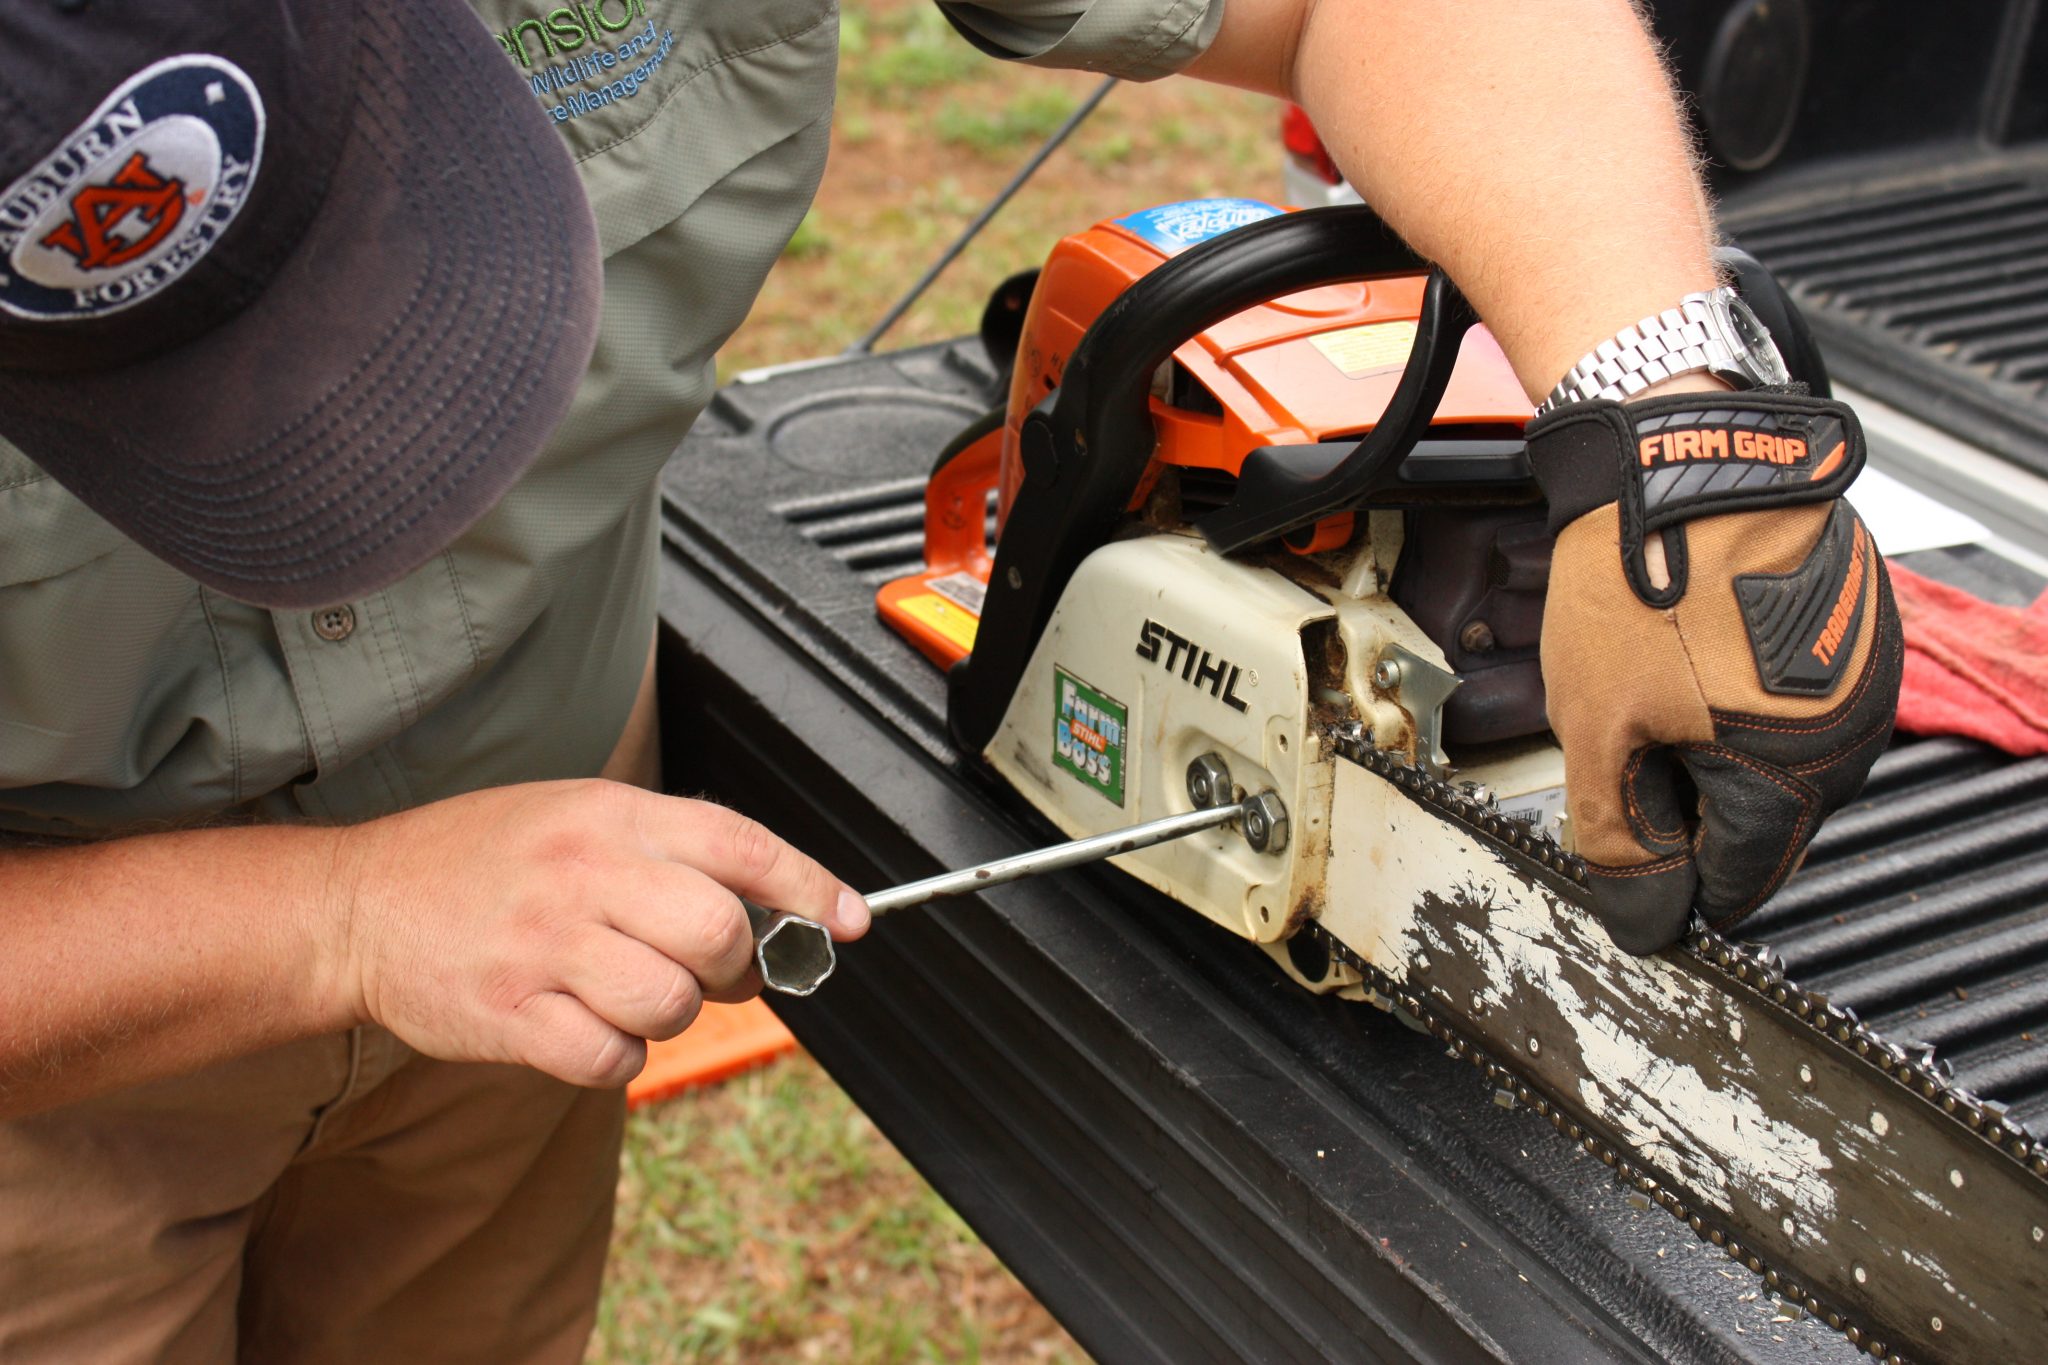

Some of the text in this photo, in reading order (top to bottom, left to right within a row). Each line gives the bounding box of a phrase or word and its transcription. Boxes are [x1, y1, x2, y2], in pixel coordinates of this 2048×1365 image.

[531, 19, 658, 97] Wildlife and
[566, 28, 674, 119] Management
[0, 96, 146, 254] AUBURN
[74, 153, 251, 308] FORESTRY
[1640, 429, 1807, 466] FIRM GRIP
[1135, 617, 1249, 714] STIHL
[1072, 722, 1104, 752] STIHL
